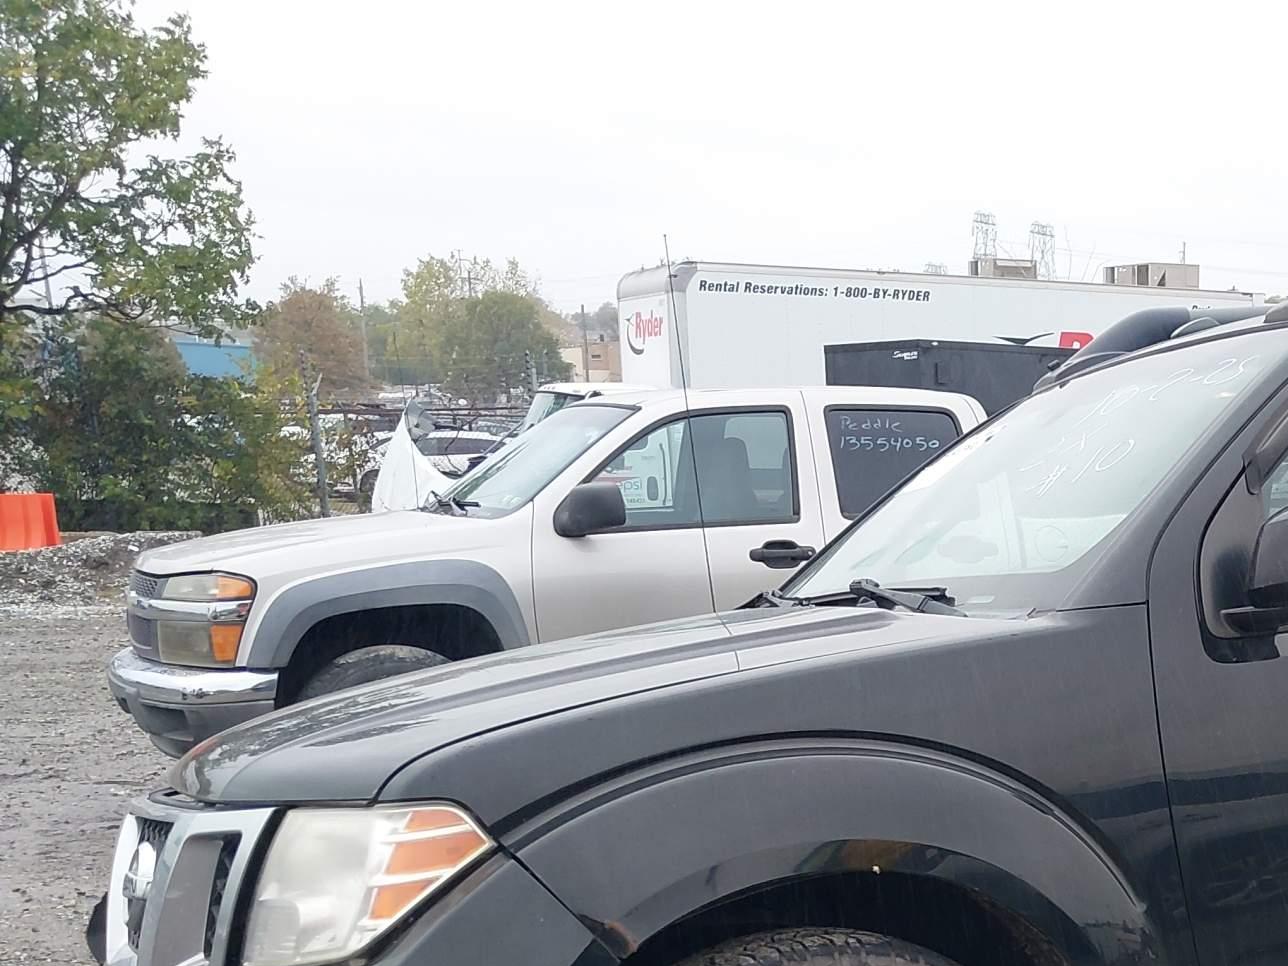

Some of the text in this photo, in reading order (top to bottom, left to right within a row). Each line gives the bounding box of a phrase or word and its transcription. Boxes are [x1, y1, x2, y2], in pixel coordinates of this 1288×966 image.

[699, 279, 931, 302] Rental Reservations: 1-800-BY-RYDER
[635, 309, 664, 345] Ryder
[840, 436, 940, 452] 13554050
